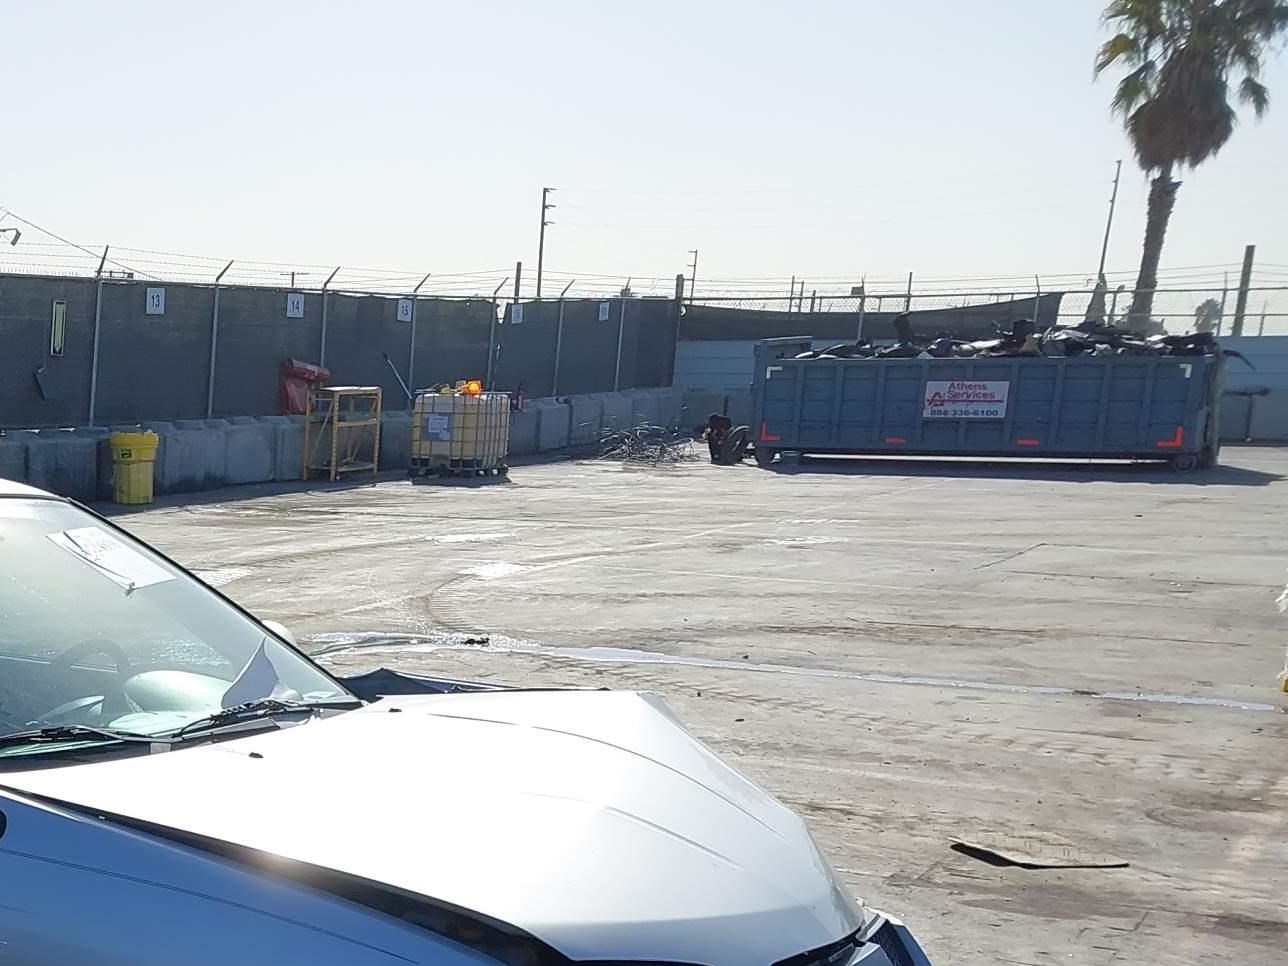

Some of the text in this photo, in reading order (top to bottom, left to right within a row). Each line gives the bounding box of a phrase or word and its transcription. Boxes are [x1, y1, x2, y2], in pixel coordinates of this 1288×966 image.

[151, 294, 161, 308] 13
[291, 299, 300, 312] 14
[947, 382, 988, 391] Athens
[947, 390, 996, 400] Services
